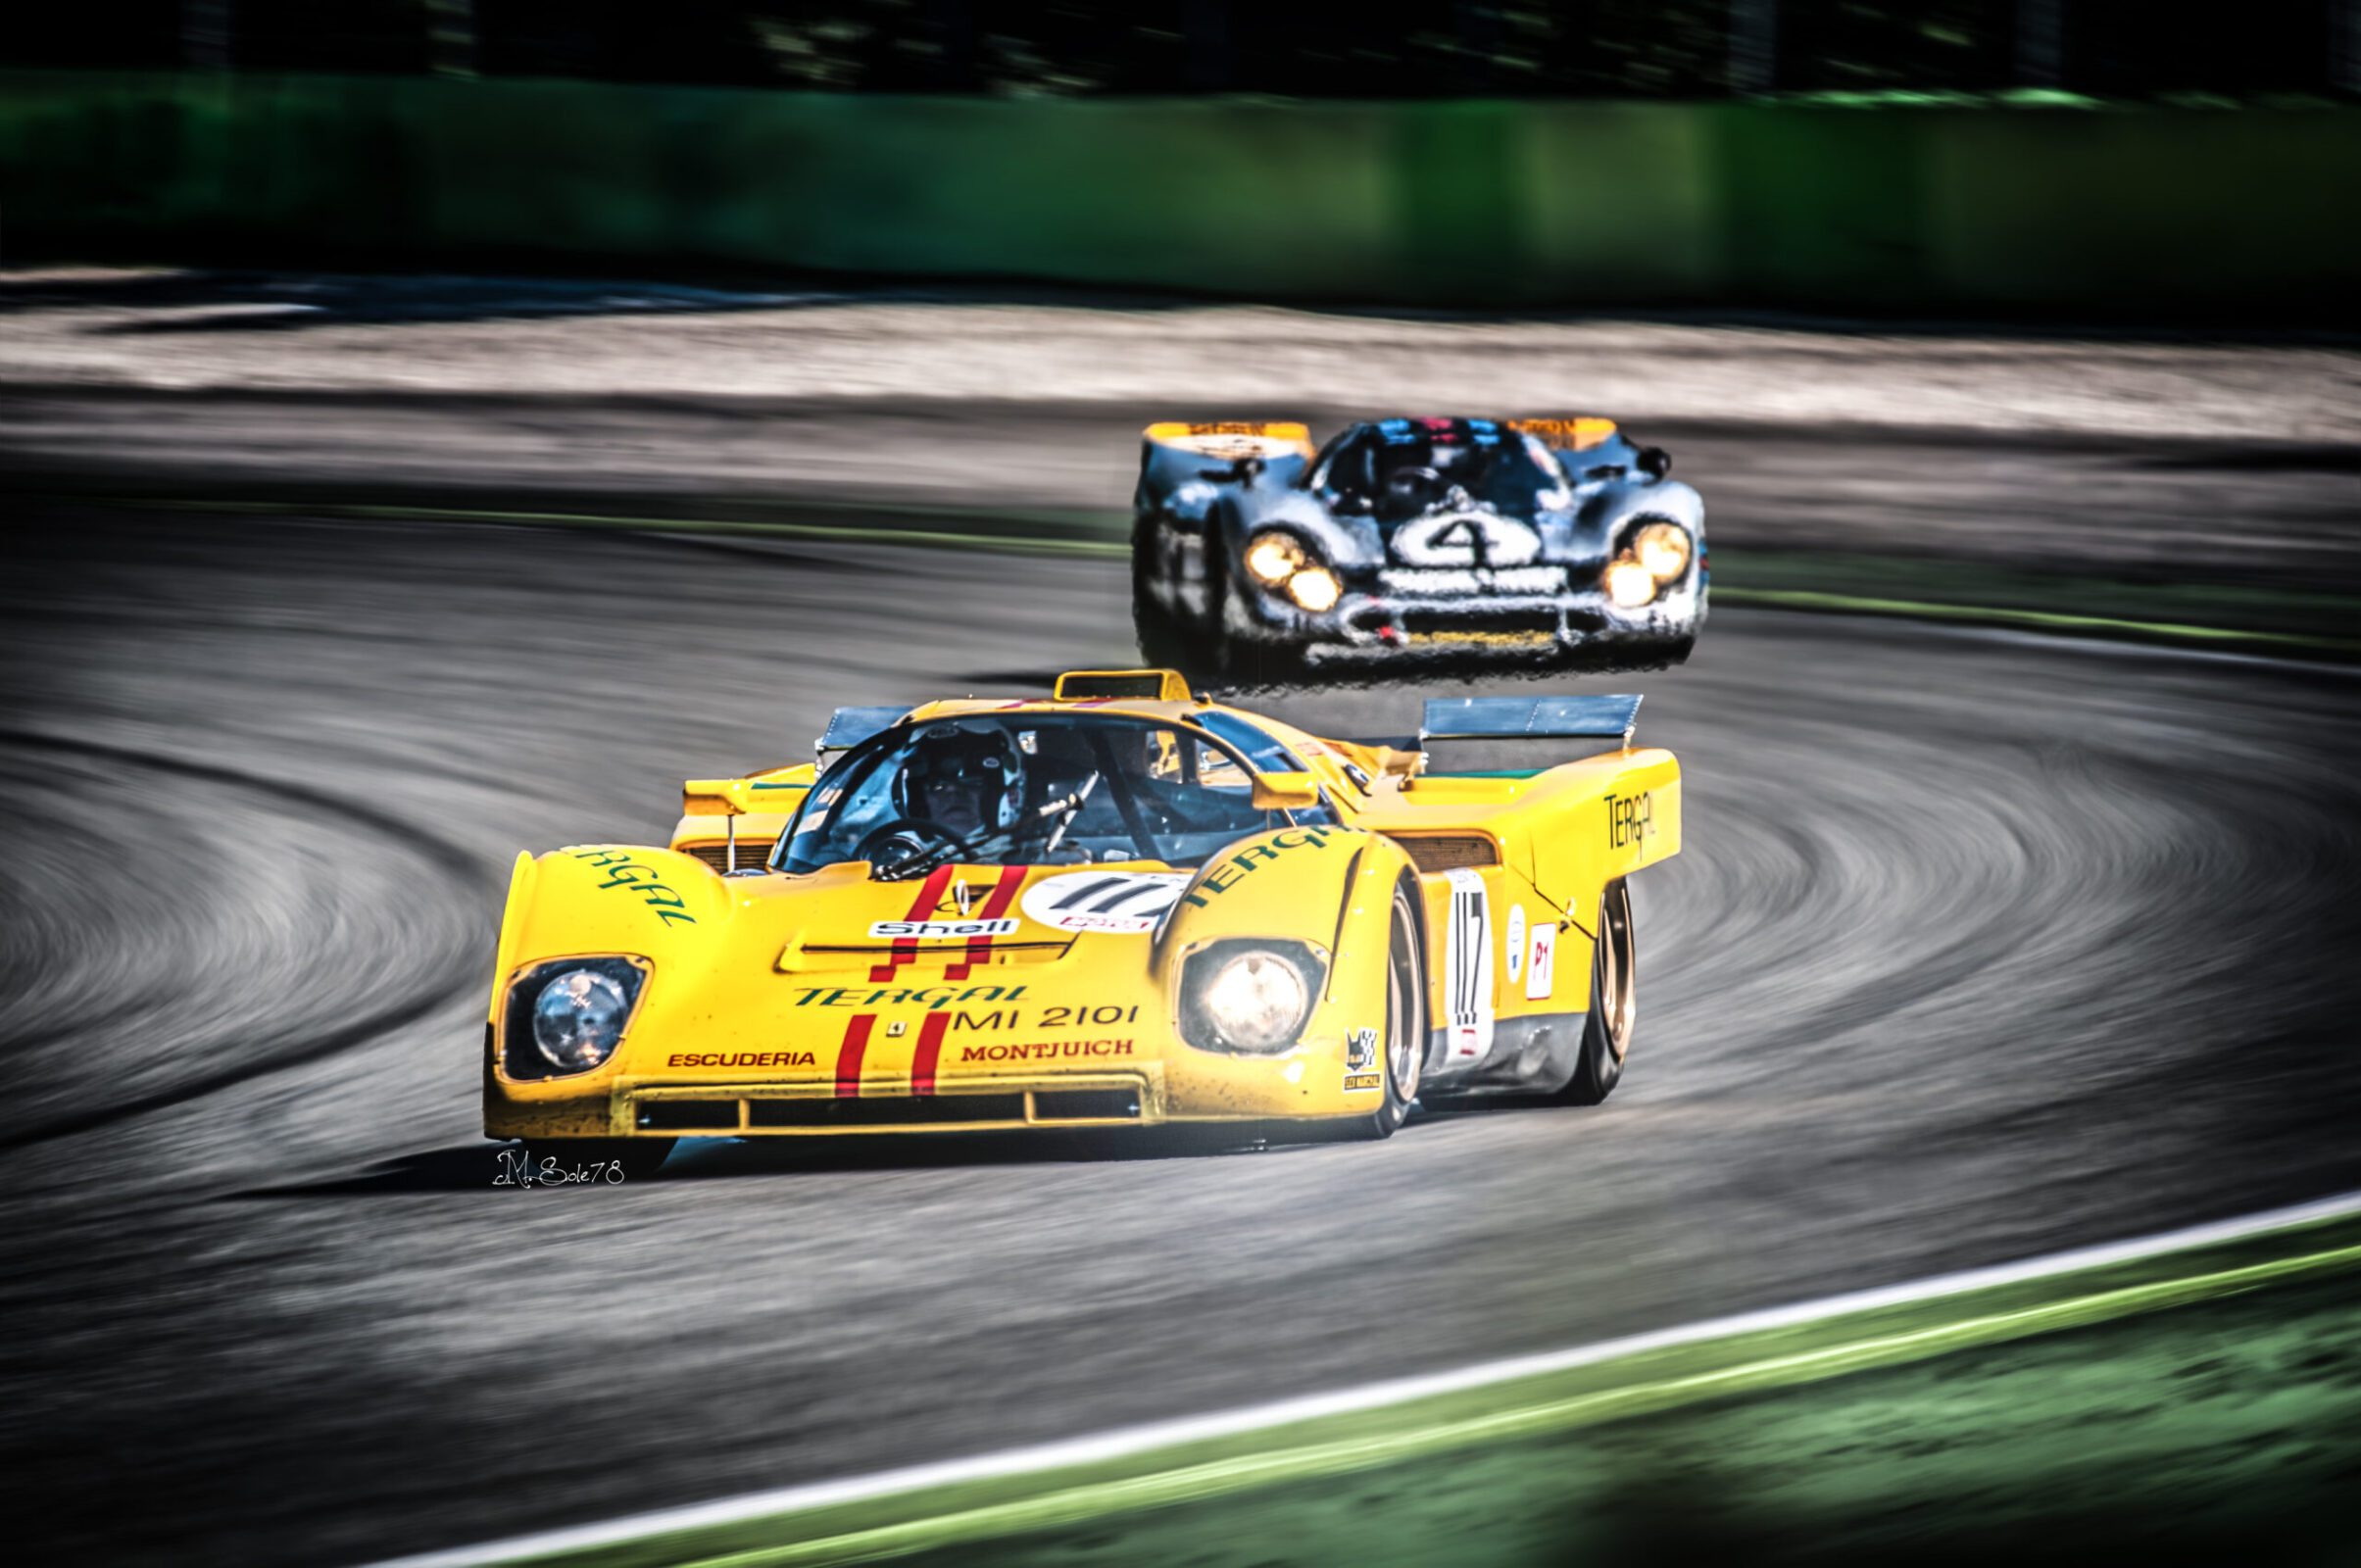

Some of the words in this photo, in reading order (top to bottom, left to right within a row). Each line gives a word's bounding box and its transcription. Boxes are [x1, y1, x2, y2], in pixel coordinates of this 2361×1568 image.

[1426, 519, 1500, 565] 4
[1182, 823, 1352, 908] TERG
[574, 850, 697, 927] RGAL
[876, 919, 1011, 936] Shell
[1455, 892, 1483, 1025] 117
[793, 985, 1030, 1009] TERGAL
[953, 1010, 1019, 1031] MI
[1038, 1005, 1140, 1029] 2101
[666, 1052, 816, 1068] ESCUDERIA
[960, 1039, 1135, 1062] MONTJUICH
